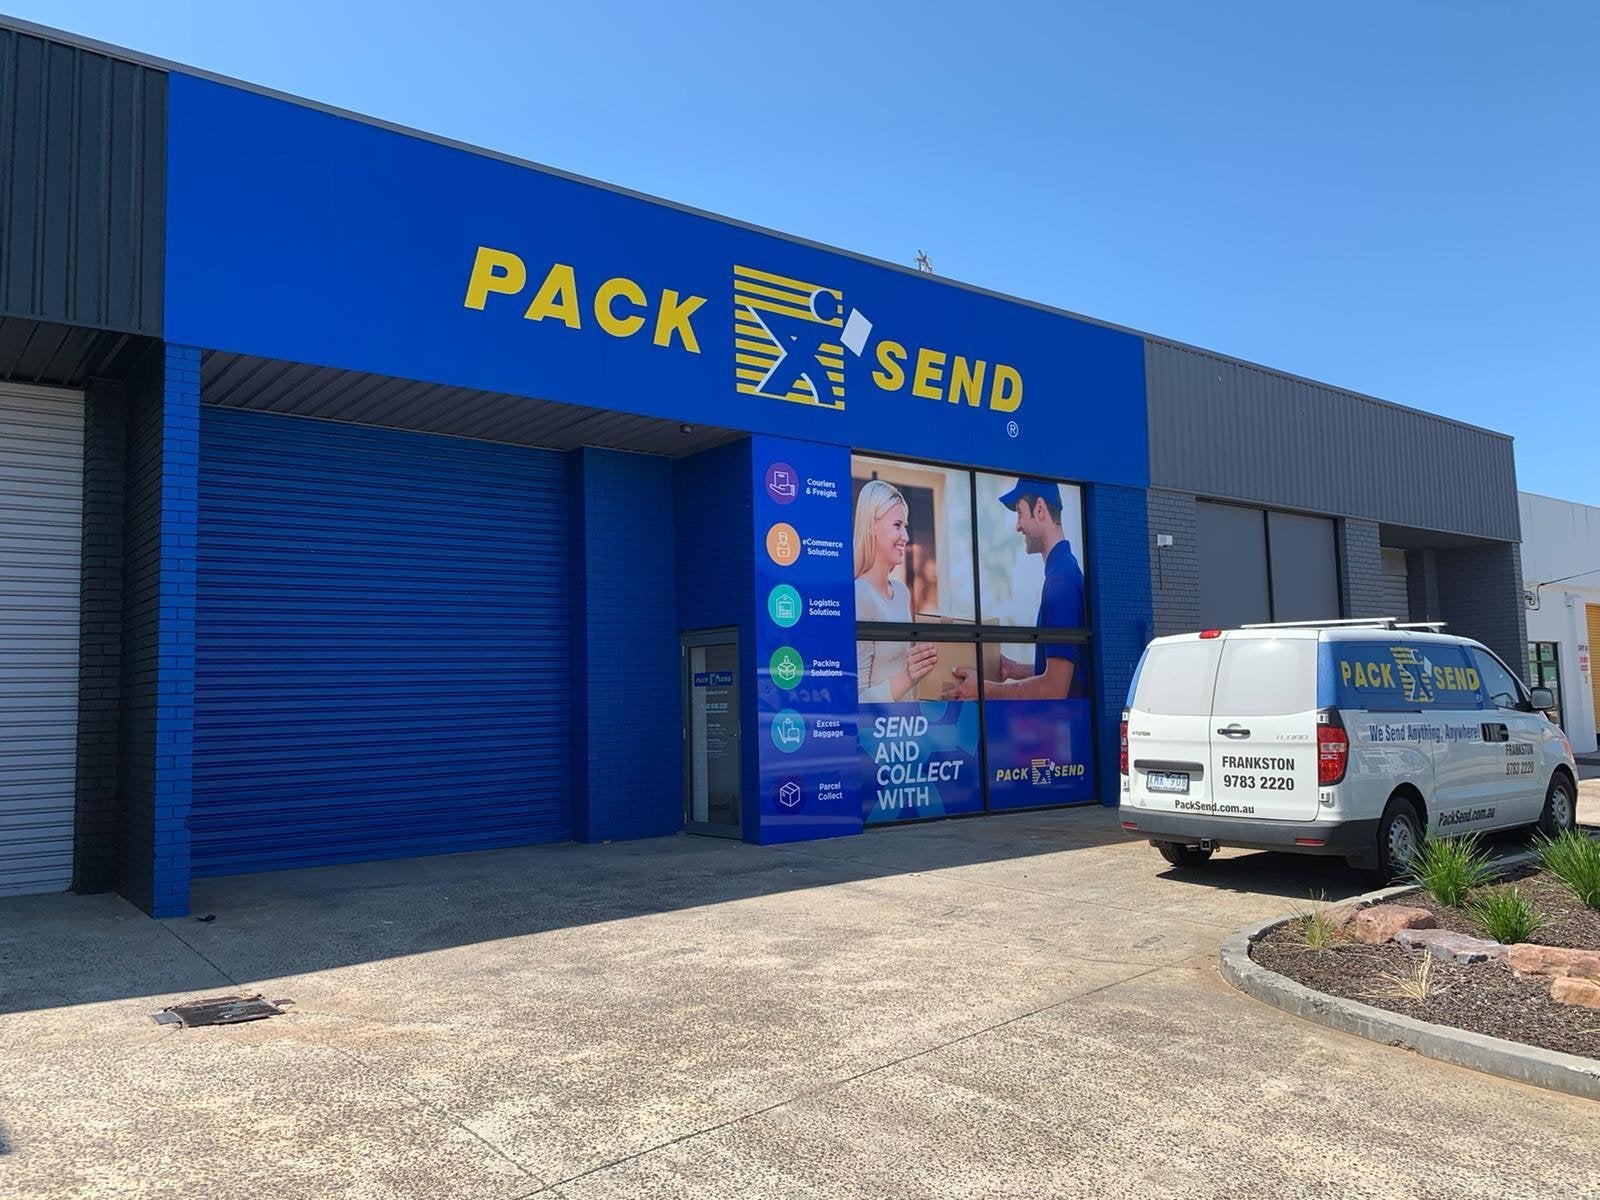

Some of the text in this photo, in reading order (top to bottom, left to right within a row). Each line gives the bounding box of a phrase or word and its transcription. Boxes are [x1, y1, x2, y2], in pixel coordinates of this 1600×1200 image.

[464, 246, 1023, 412] PACK SEND
[807, 478, 836, 488] Couriers
[812, 488, 837, 498] Freight
[802, 538, 843, 548] eCommerce
[807, 548, 839, 557] Solutions
[809, 598, 840, 608] Logistics
[808, 607, 841, 617] Solutions
[812, 659, 840, 669] Packing
[810, 668, 843, 677] Solutions
[1340, 661, 1480, 690] PACK SEND
[816, 719, 840, 728] Excess
[873, 716, 928, 738] SEND
[813, 729, 844, 739] Baggage
[1369, 724, 1383, 741] We
[1385, 724, 1405, 741] Send
[1445, 723, 1480, 742] Anywhere!
[874, 740, 920, 763] AND
[1505, 743, 1534, 756] FRANKSTON
[1222, 756, 1295, 770] FRANKSTON
[1506, 761, 1534, 775] 9783 2220
[876, 760, 964, 785] COLLECT
[996, 763, 1085, 782] PACK SEND
[819, 781, 841, 790] Parcel
[1223, 774, 1295, 791] 9783 2220
[818, 791, 843, 801] Collect
[877, 786, 930, 810] WITH
[1174, 800, 1255, 814] PackSend.com.au
[1438, 807, 1495, 827] PackSend.com.au
